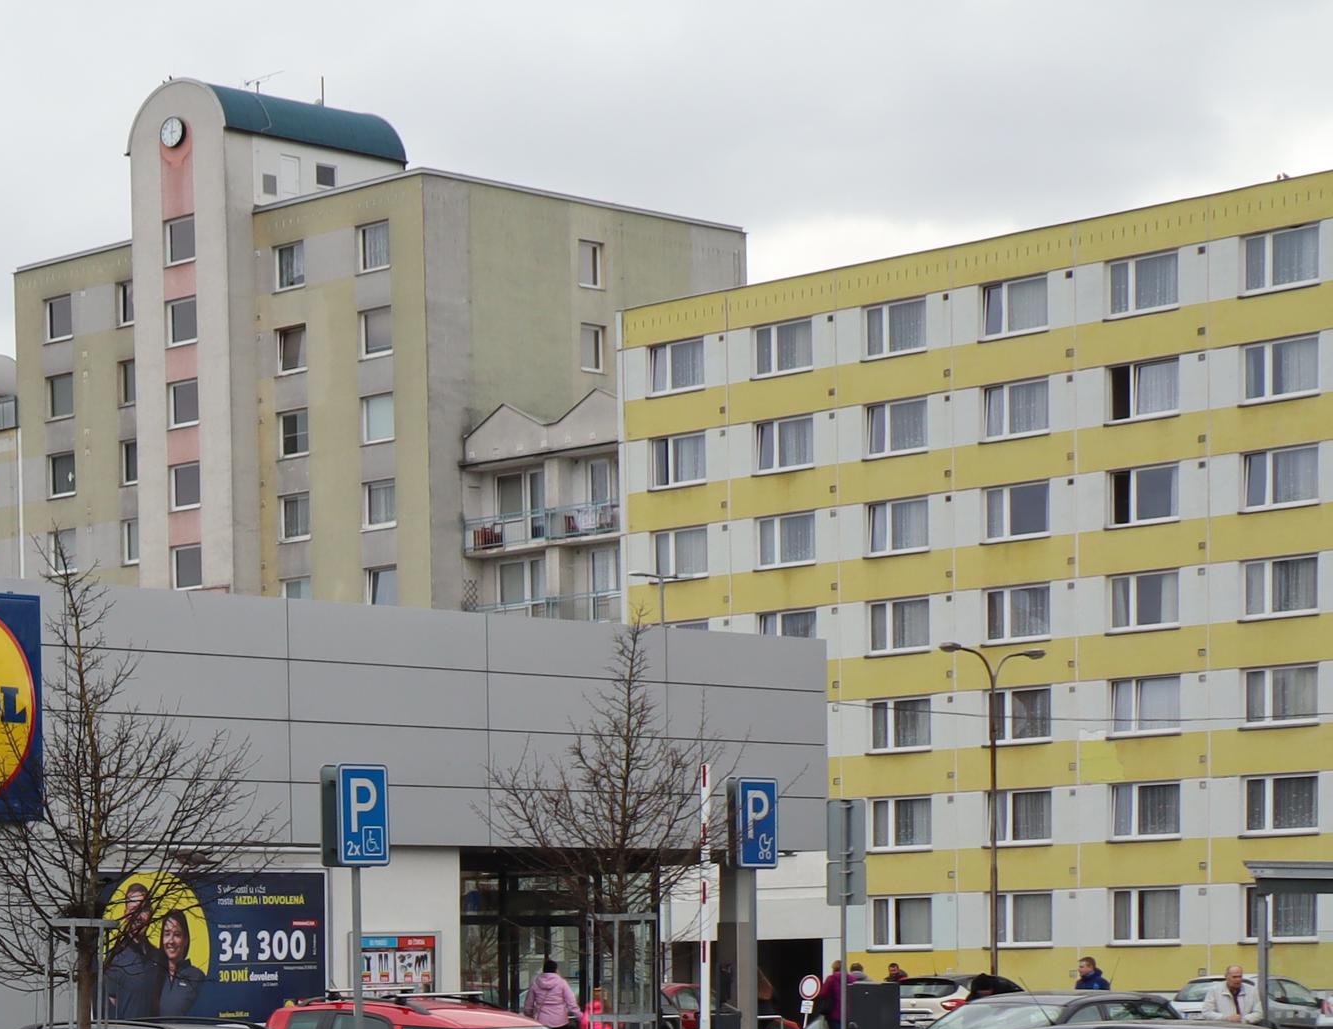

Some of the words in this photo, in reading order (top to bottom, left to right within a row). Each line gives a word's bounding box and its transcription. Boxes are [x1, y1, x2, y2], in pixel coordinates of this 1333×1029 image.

[350, 778, 377, 832] P
[747, 790, 769, 839] P
[347, 841, 361, 856] 2x
[263, 894, 305, 905] DOVOLENÁ
[219, 931, 249, 961] 34
[257, 930, 306, 960] 300
[219, 970, 230, 982] 30
[231, 968, 248, 982] DNÍ
